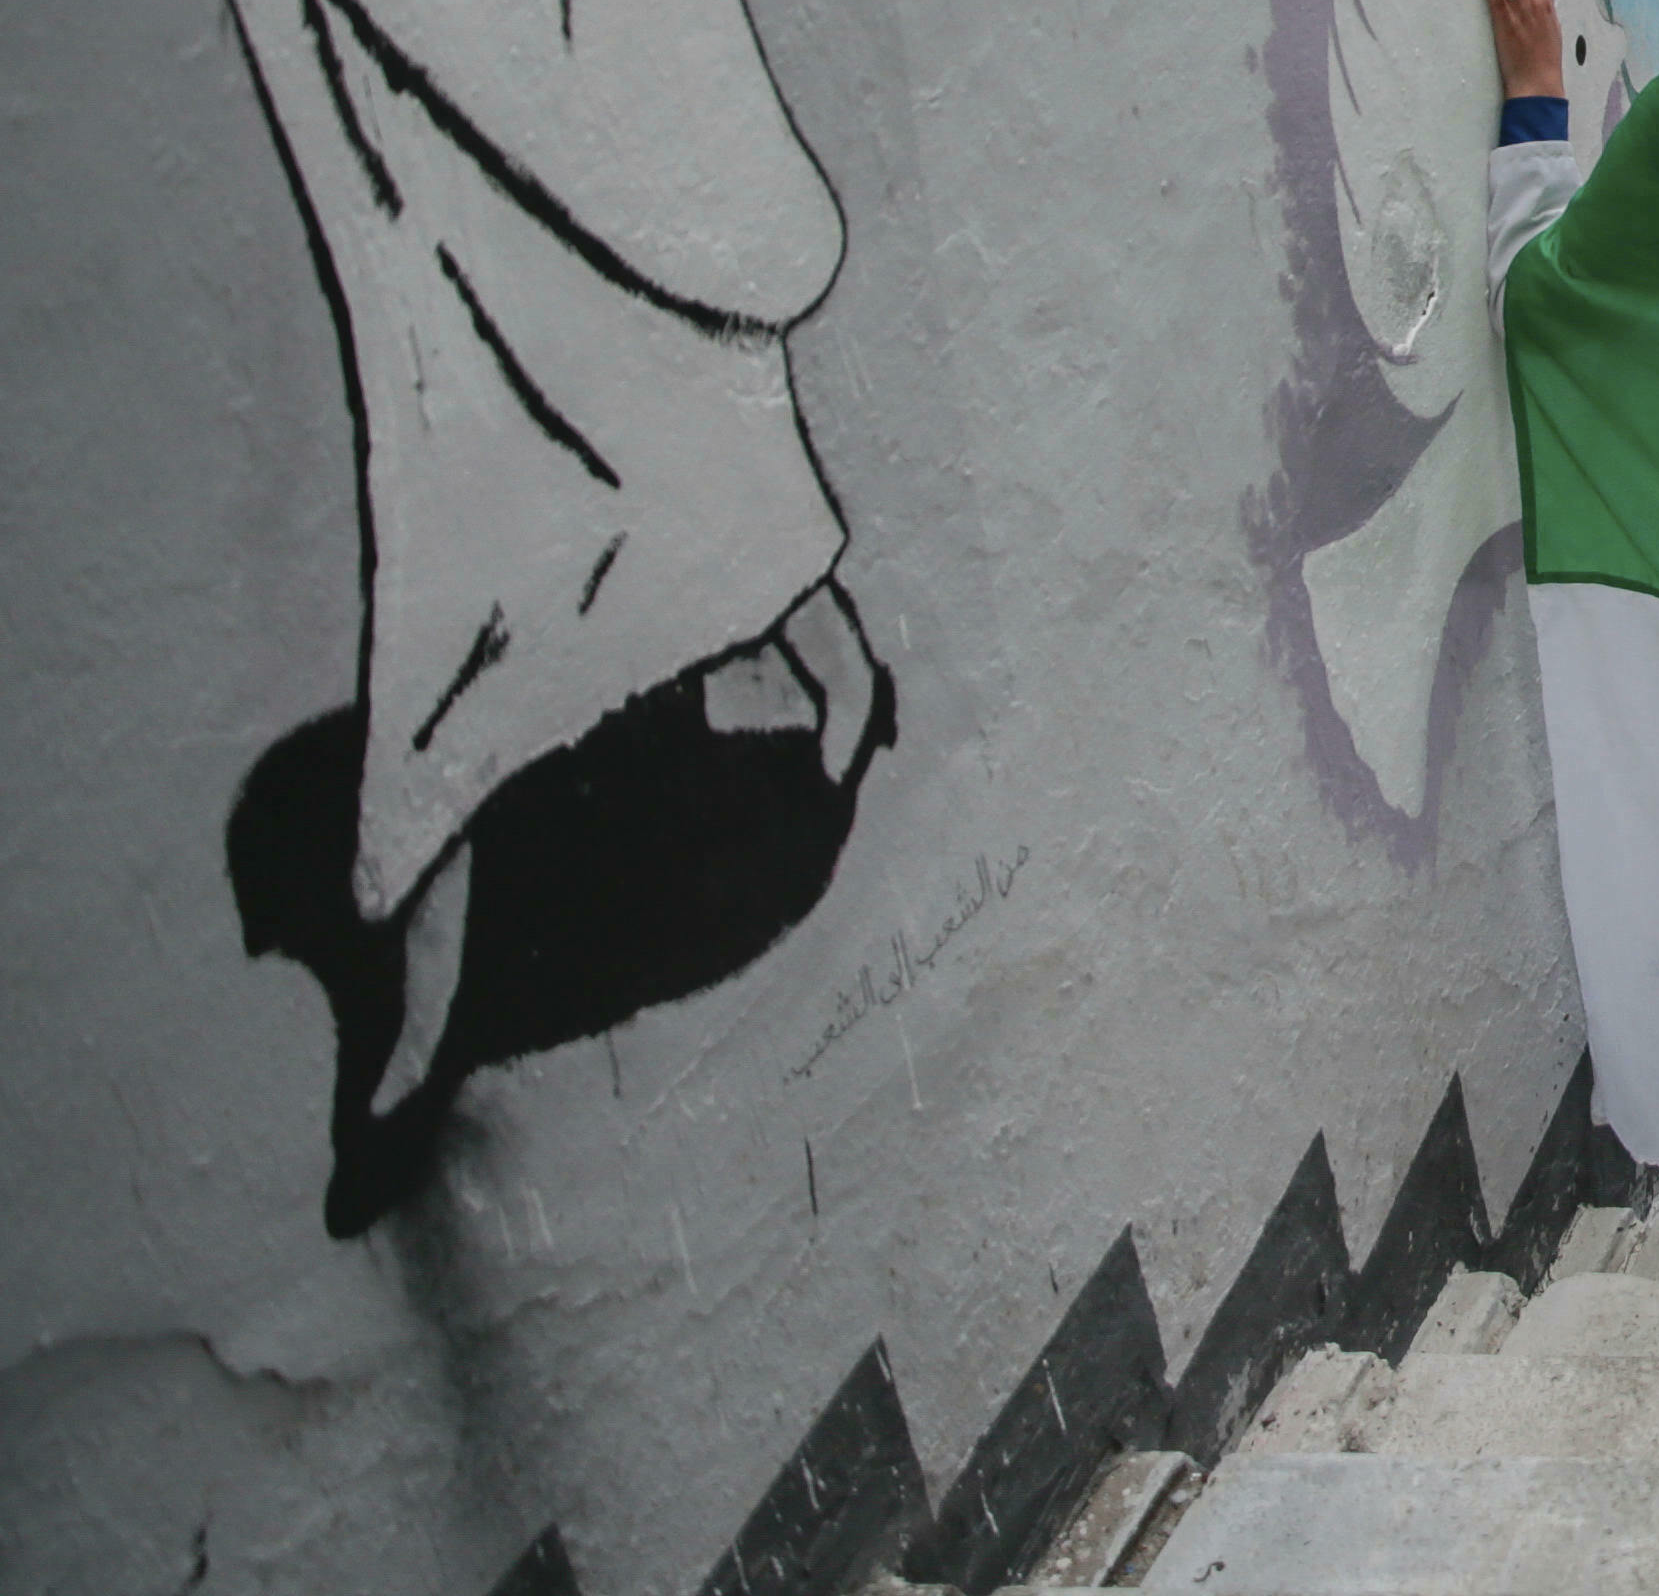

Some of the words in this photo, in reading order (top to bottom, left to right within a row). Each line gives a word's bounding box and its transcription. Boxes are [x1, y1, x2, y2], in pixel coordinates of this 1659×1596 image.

[916, 853, 993, 970] الشعب
[998, 844, 1030, 898] من
[791, 965, 878, 1080] الشعب
